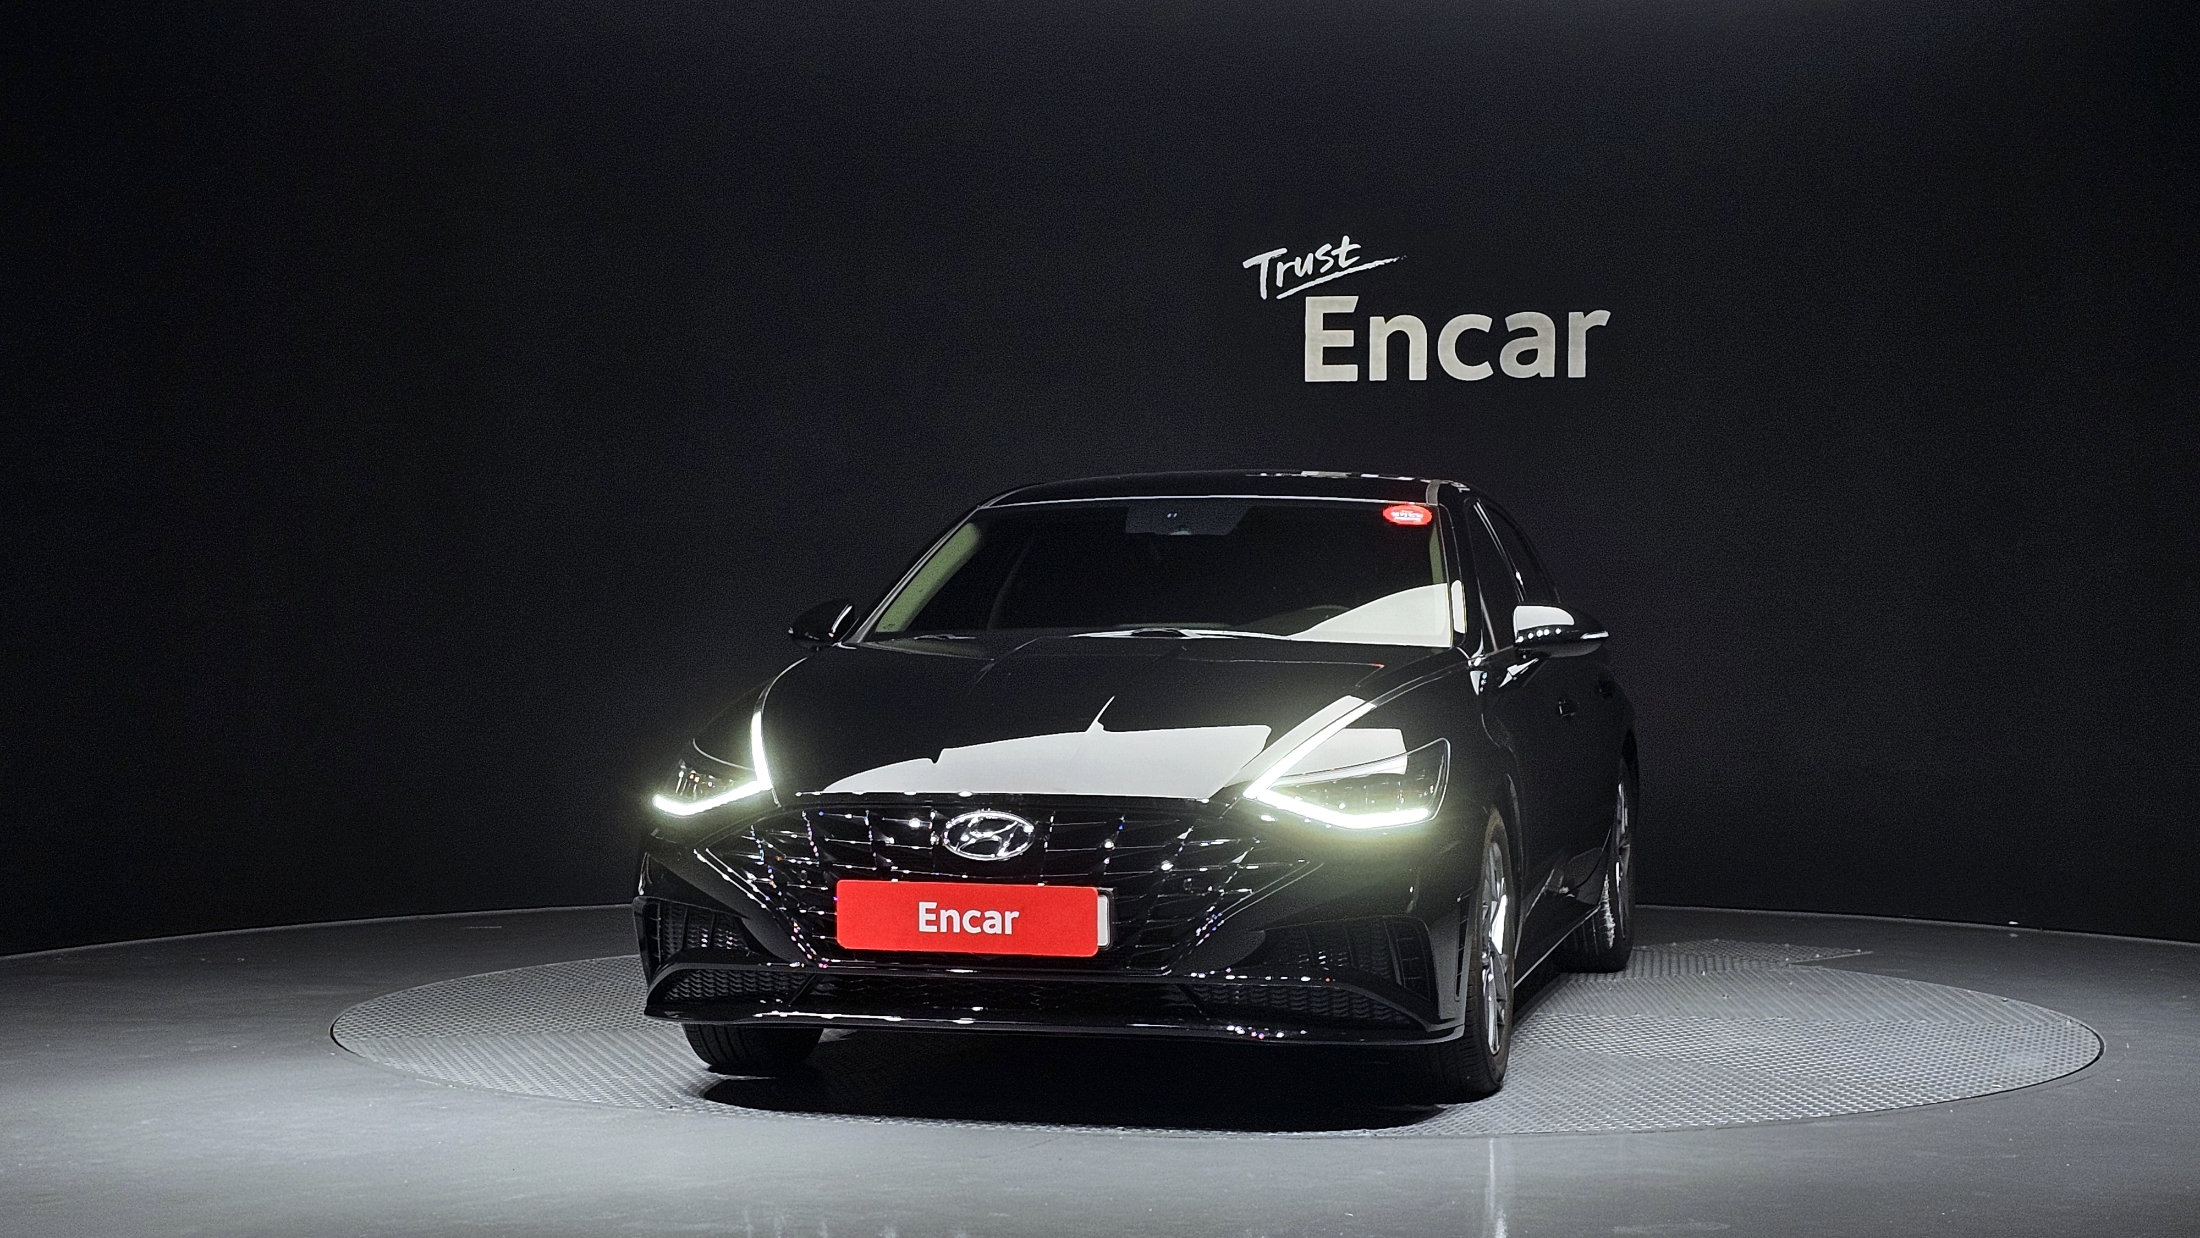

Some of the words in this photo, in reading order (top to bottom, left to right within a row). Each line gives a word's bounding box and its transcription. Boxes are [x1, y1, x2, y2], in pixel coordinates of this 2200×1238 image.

[1242, 235, 1362, 300] Trust
[1304, 295, 1611, 382] Encar
[918, 901, 1019, 935] Encar
